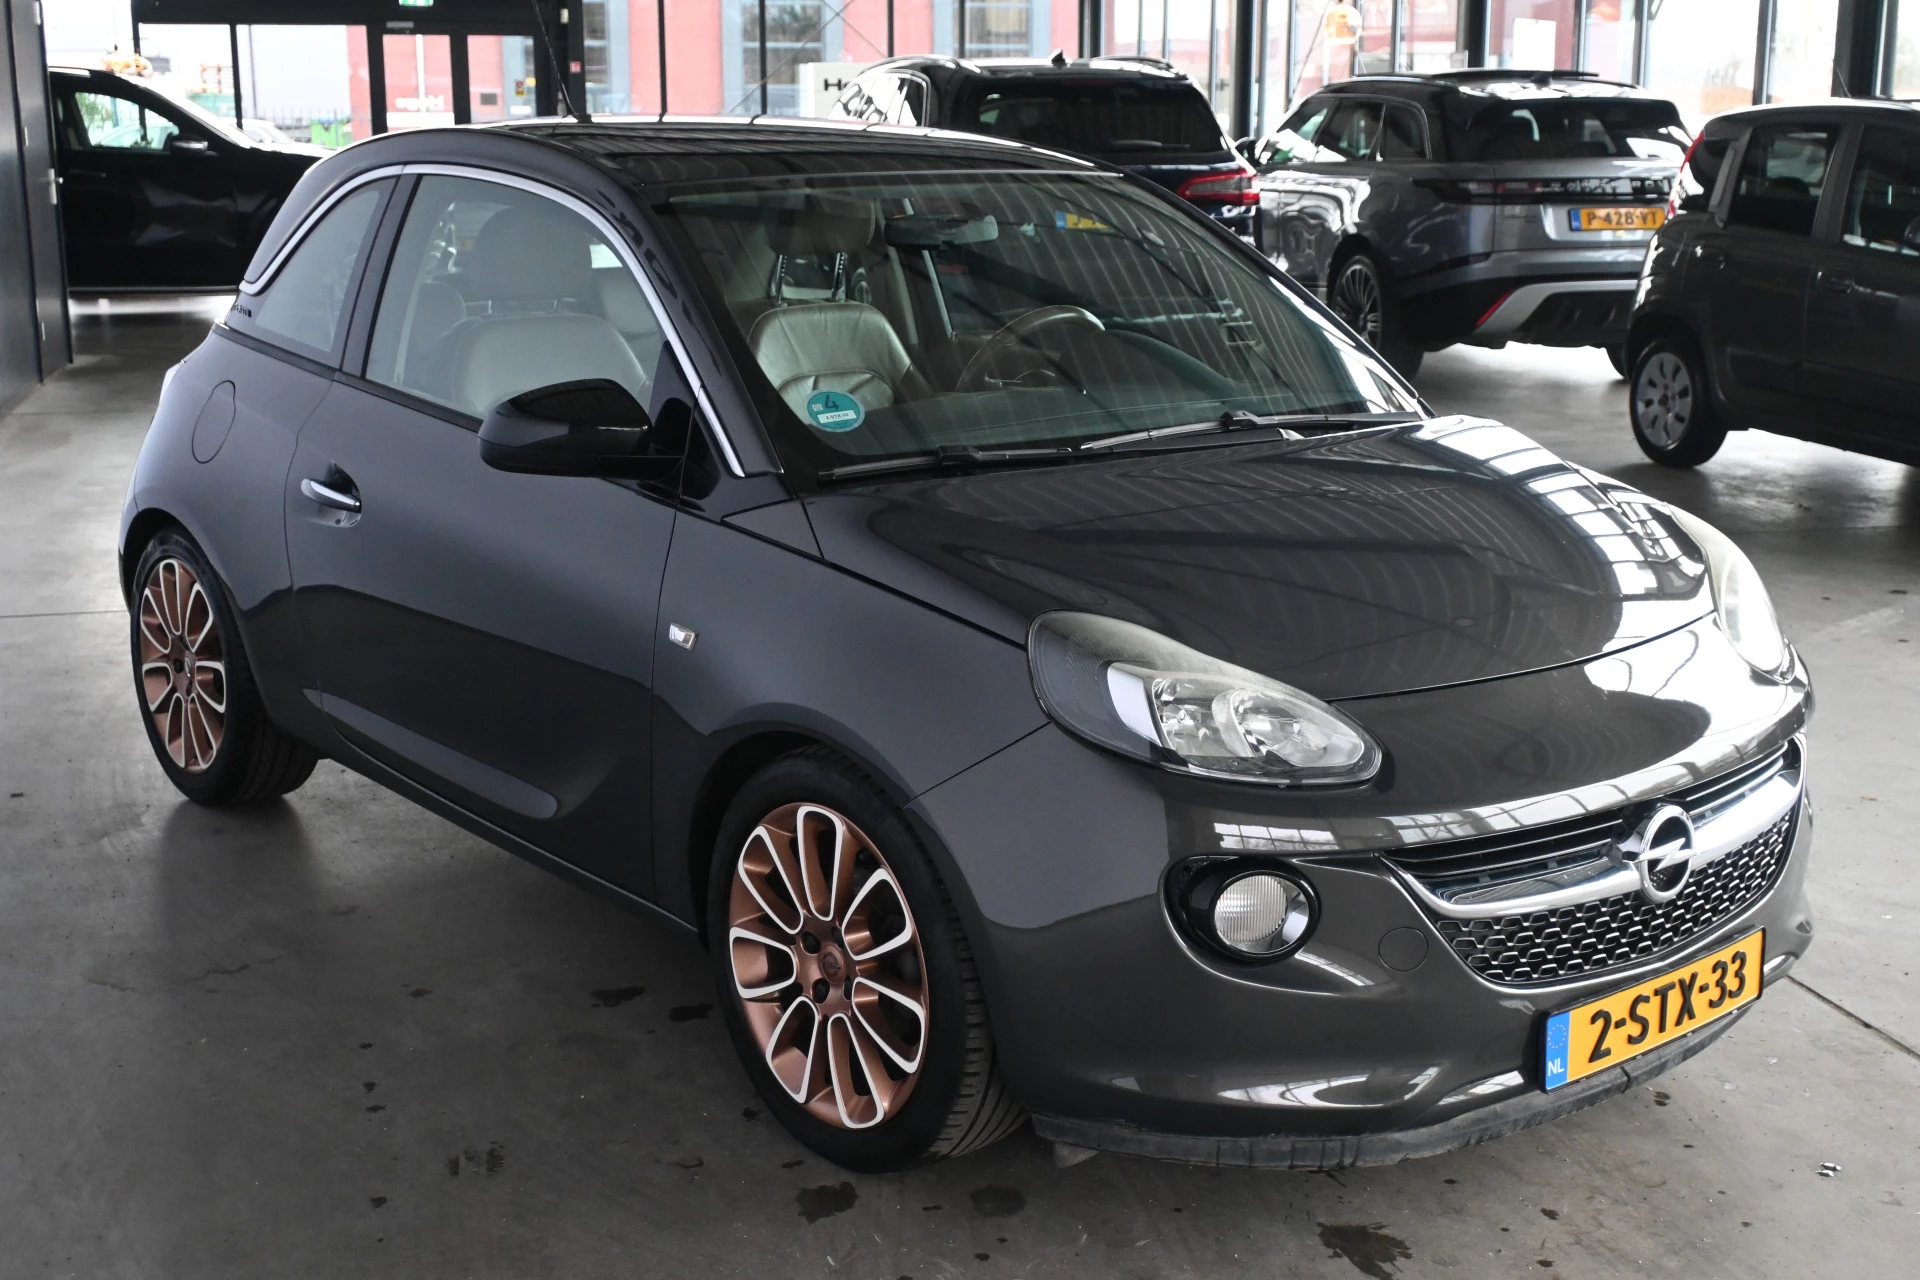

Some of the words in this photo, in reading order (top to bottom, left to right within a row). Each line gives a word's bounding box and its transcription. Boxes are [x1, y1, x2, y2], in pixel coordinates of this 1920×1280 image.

[1586, 211, 1657, 226] P-428-VT
[825, 394, 839, 409] 4
[1588, 950, 1748, 1064] 2-STX-33
[1547, 1057, 1565, 1077] NL
